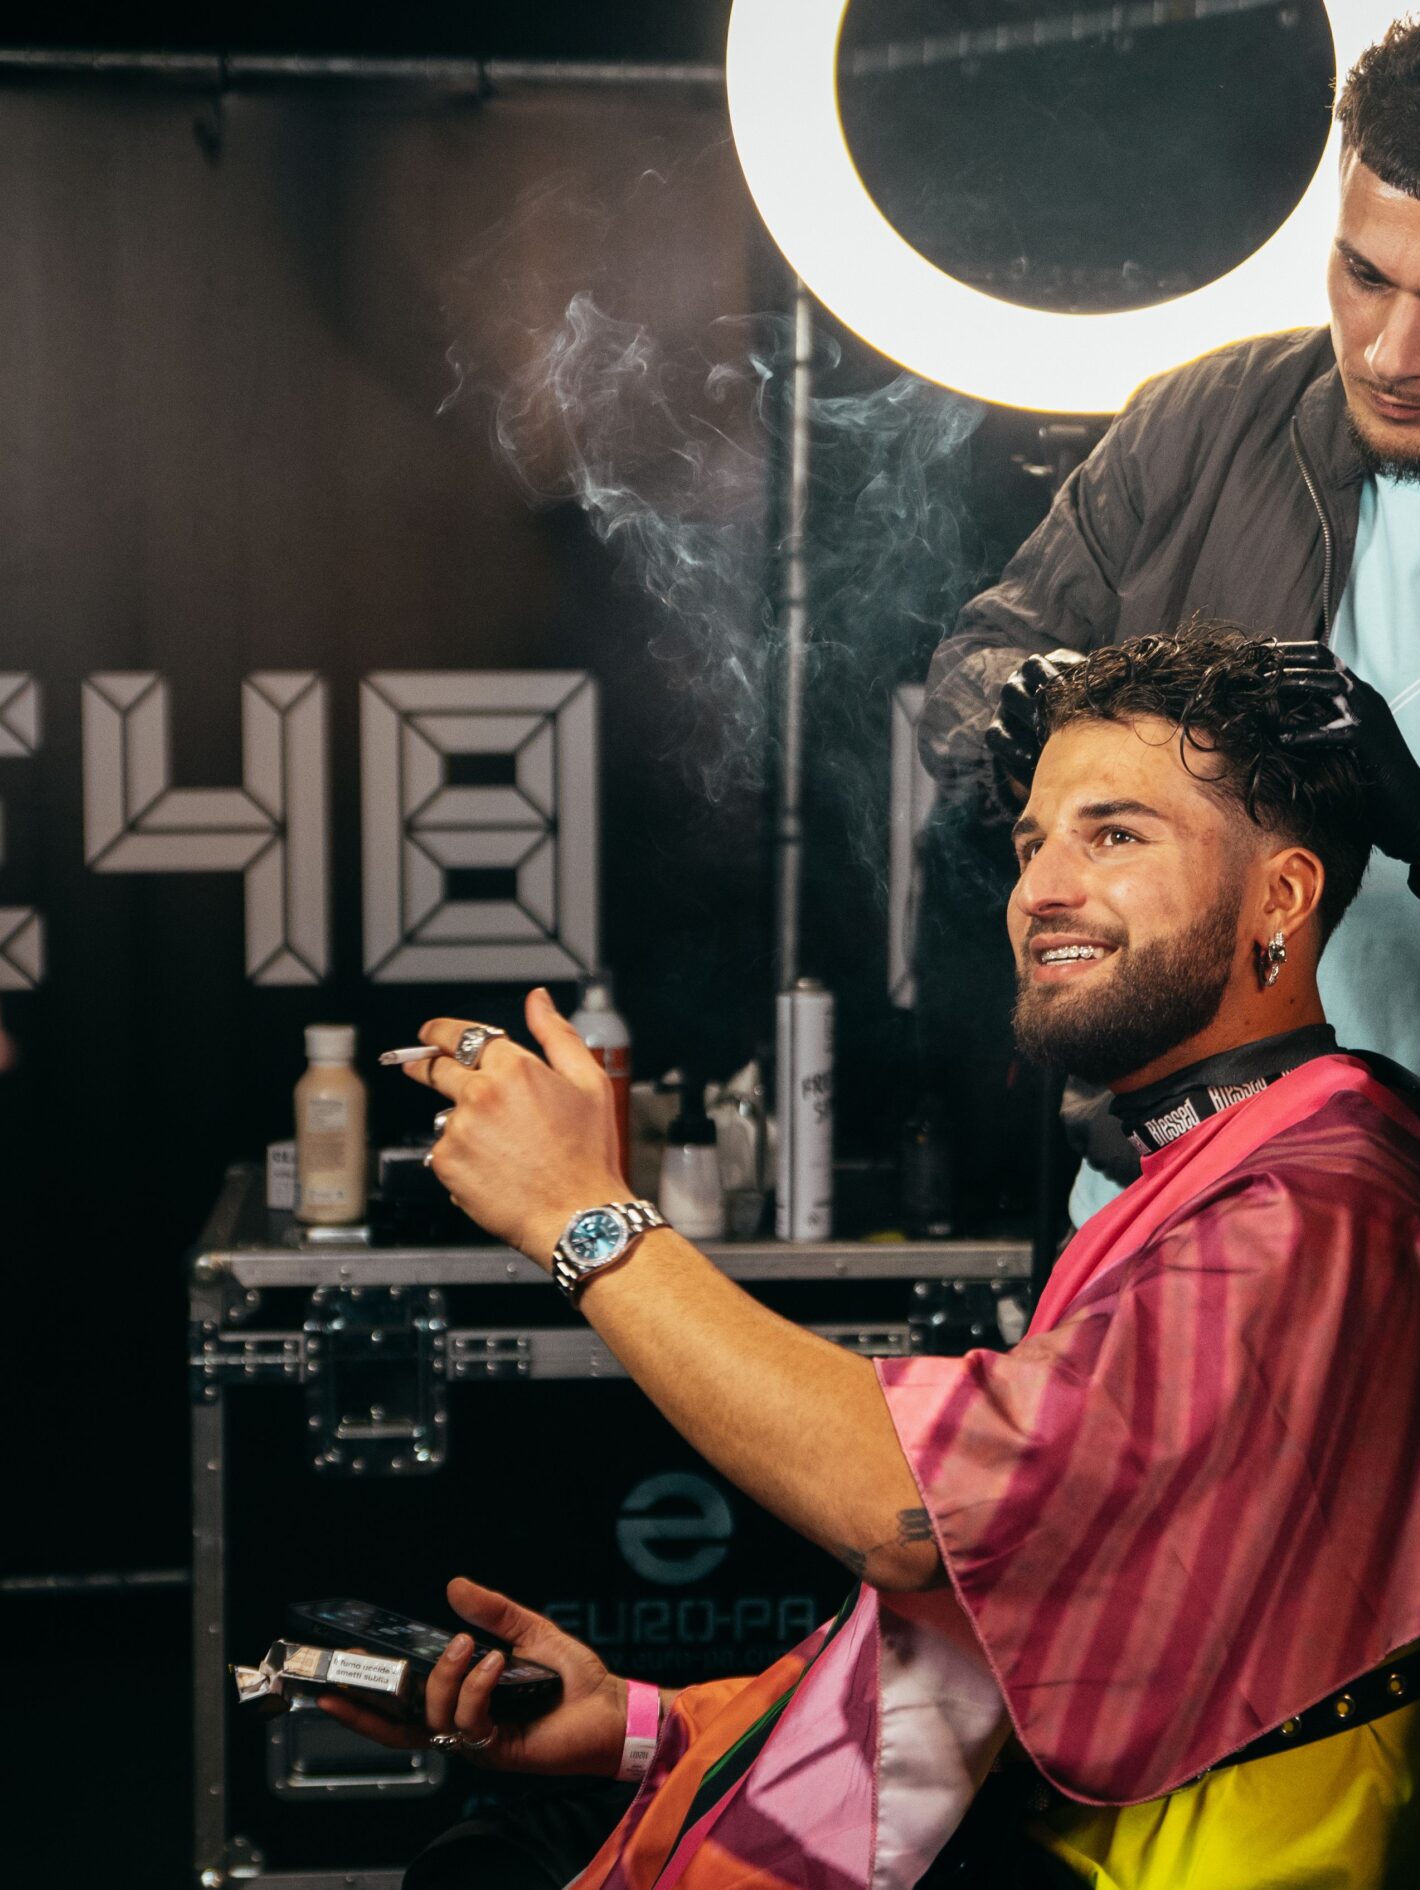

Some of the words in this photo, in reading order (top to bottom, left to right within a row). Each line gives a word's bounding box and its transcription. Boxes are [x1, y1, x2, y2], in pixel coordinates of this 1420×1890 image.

[0, 670, 601, 988] 48
[1144, 1096, 1201, 1147] Blessed
[340, 1659, 361, 1670] fumo
[363, 1665, 391, 1674] uccide
